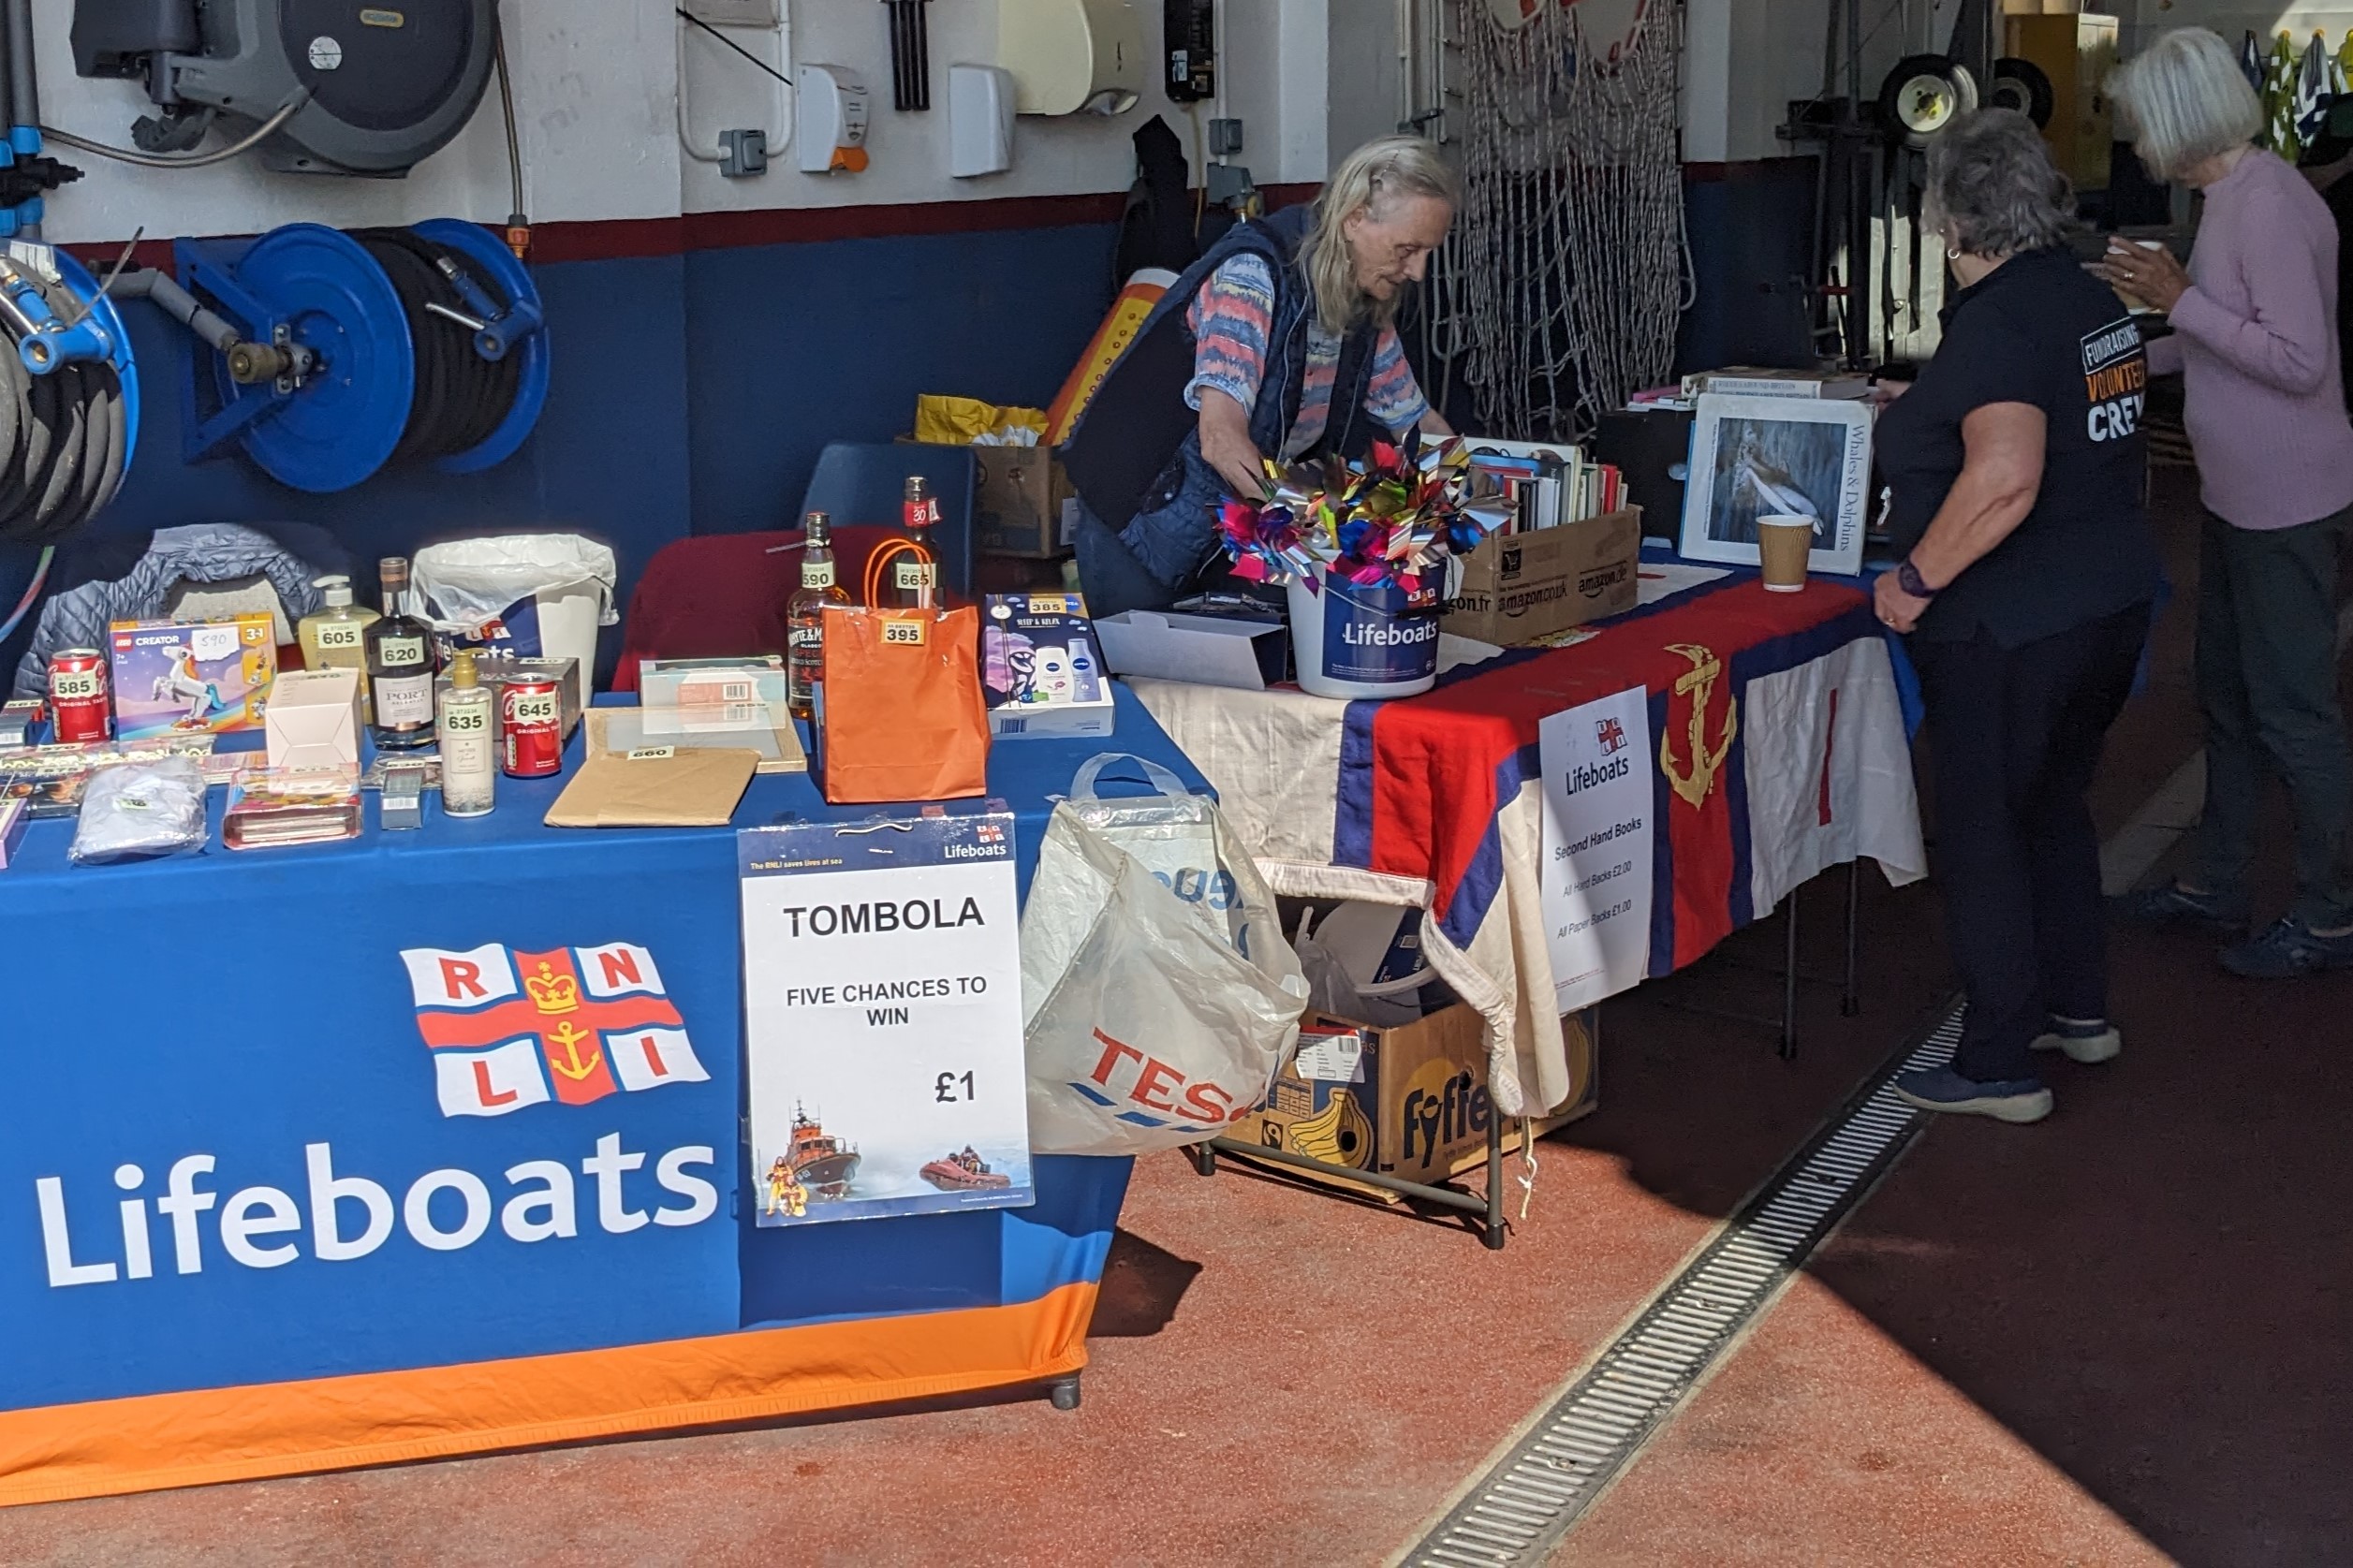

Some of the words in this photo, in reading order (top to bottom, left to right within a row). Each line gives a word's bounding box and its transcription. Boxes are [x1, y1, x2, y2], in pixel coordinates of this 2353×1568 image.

[1848, 424, 1865, 475] Whales
[1847, 477, 1860, 487] &
[1839, 491, 1860, 551] Dolphins
[900, 573, 930, 586] 665
[1578, 564, 1627, 593] amazon.de
[1032, 603, 1061, 611] 385
[135, 636, 180, 647] CREATOR
[201, 634, 228, 647] 590
[322, 632, 355, 644] 605
[788, 627, 823, 648] WHYTE&M
[887, 629, 919, 641] 395
[1344, 620, 1438, 646] Lifeboats
[384, 648, 418, 662] 620
[57, 681, 91, 695] 585
[386, 688, 428, 701] PORT
[518, 703, 551, 717] 645
[449, 715, 483, 730] 635
[633, 749, 668, 758] 660
[1565, 755, 1629, 797] Lifeboats
[1554, 833, 1589, 861] Second
[1590, 825, 1613, 850] Hand
[1614, 816, 1642, 840] Books
[944, 843, 1007, 859] Lifeboats
[1563, 882, 1573, 898] All
[1573, 876, 1591, 894] Hard
[1591, 869, 1612, 888] Backs
[1612, 860, 1633, 881] £2.00
[782, 896, 986, 938] TOMBOLA
[1557, 923, 1567, 940] All
[1567, 917, 1590, 937] Paper
[1591, 908, 1611, 929] Backs
[1611, 899, 1632, 919] £1.00
[438, 956, 489, 1000] R
[595, 947, 644, 989] N
[787, 986, 835, 1006] FIVE
[842, 978, 950, 1003] CHANCES
[956, 975, 988, 995] TO
[866, 1007, 909, 1027] WIN
[470, 1059, 519, 1108] L
[1090, 1026, 1260, 1123] TES
[934, 1070, 976, 1103] £1
[36, 1130, 719, 1288] Lifeboats
